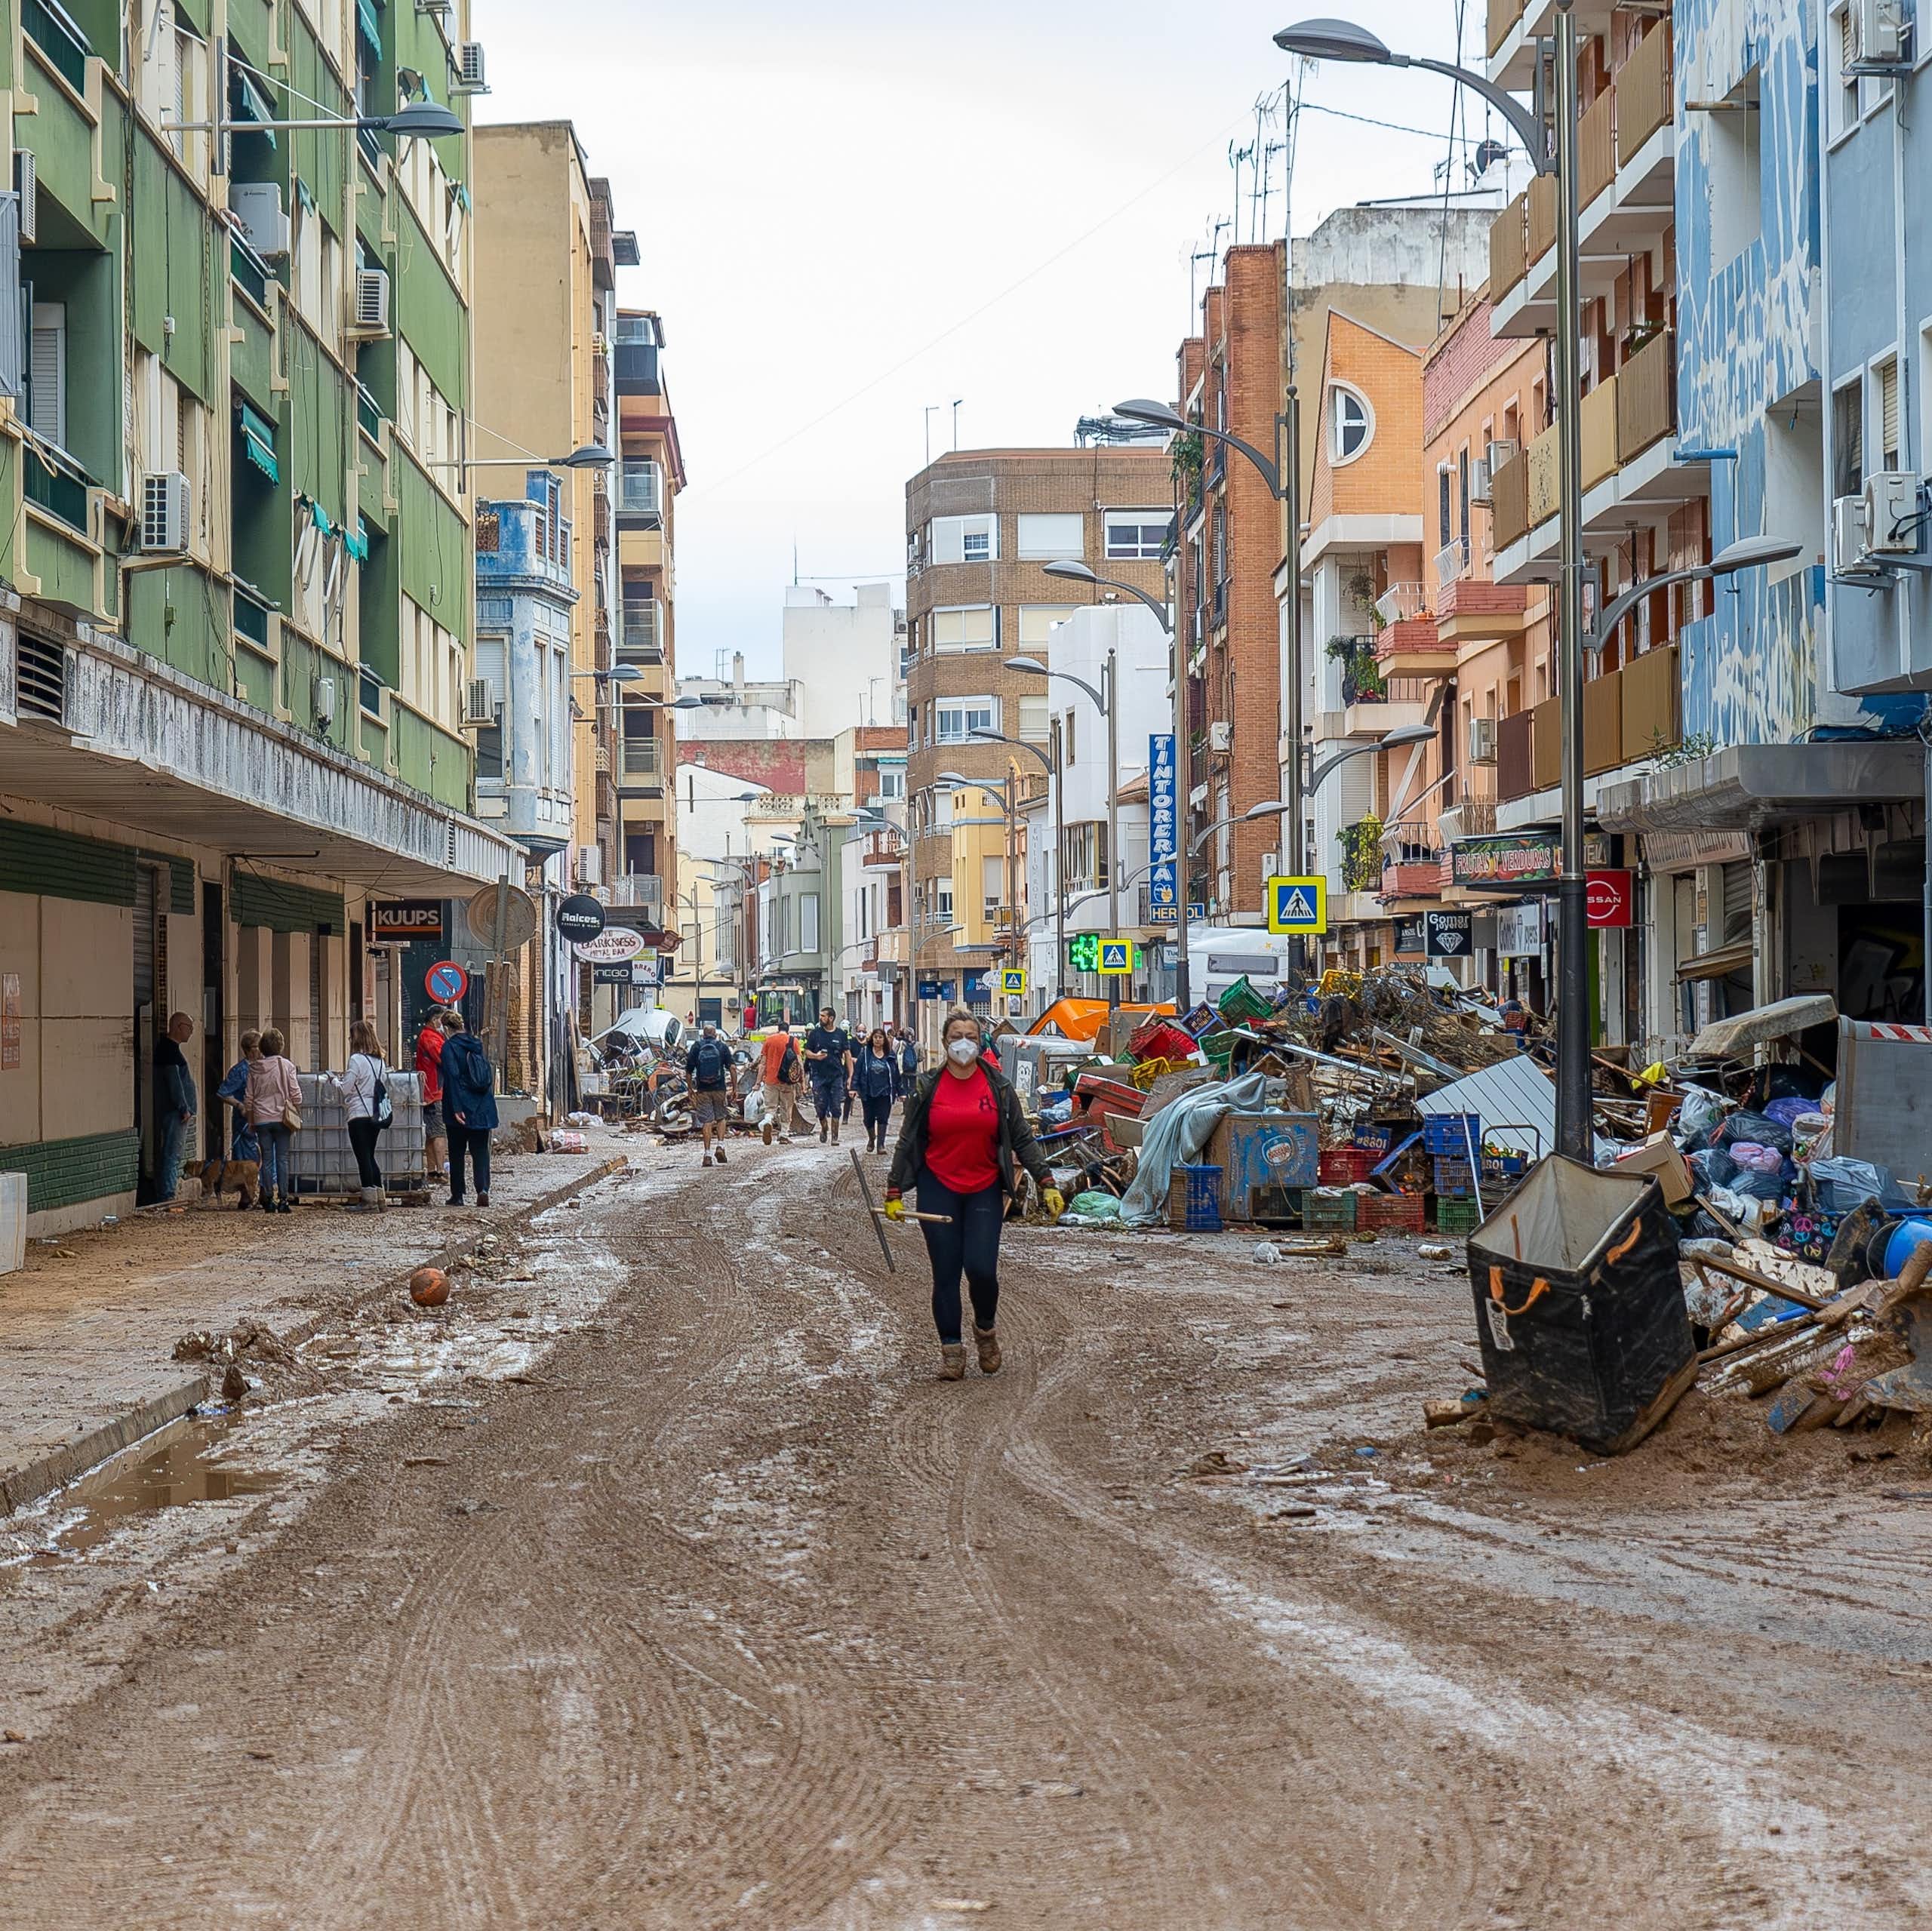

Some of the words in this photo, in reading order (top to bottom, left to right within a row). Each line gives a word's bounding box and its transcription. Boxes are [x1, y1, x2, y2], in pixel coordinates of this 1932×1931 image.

[1152, 736, 1173, 882] TINTORERIA
[1455, 851, 1491, 875] FRUTAS
[1492, 850, 1499, 872] Y
[1501, 847, 1551, 871] VERDURAS
[378, 910, 438, 925] KUUPS
[1152, 907, 1202, 920] HEROL
[1429, 913, 1469, 924] Gomar
